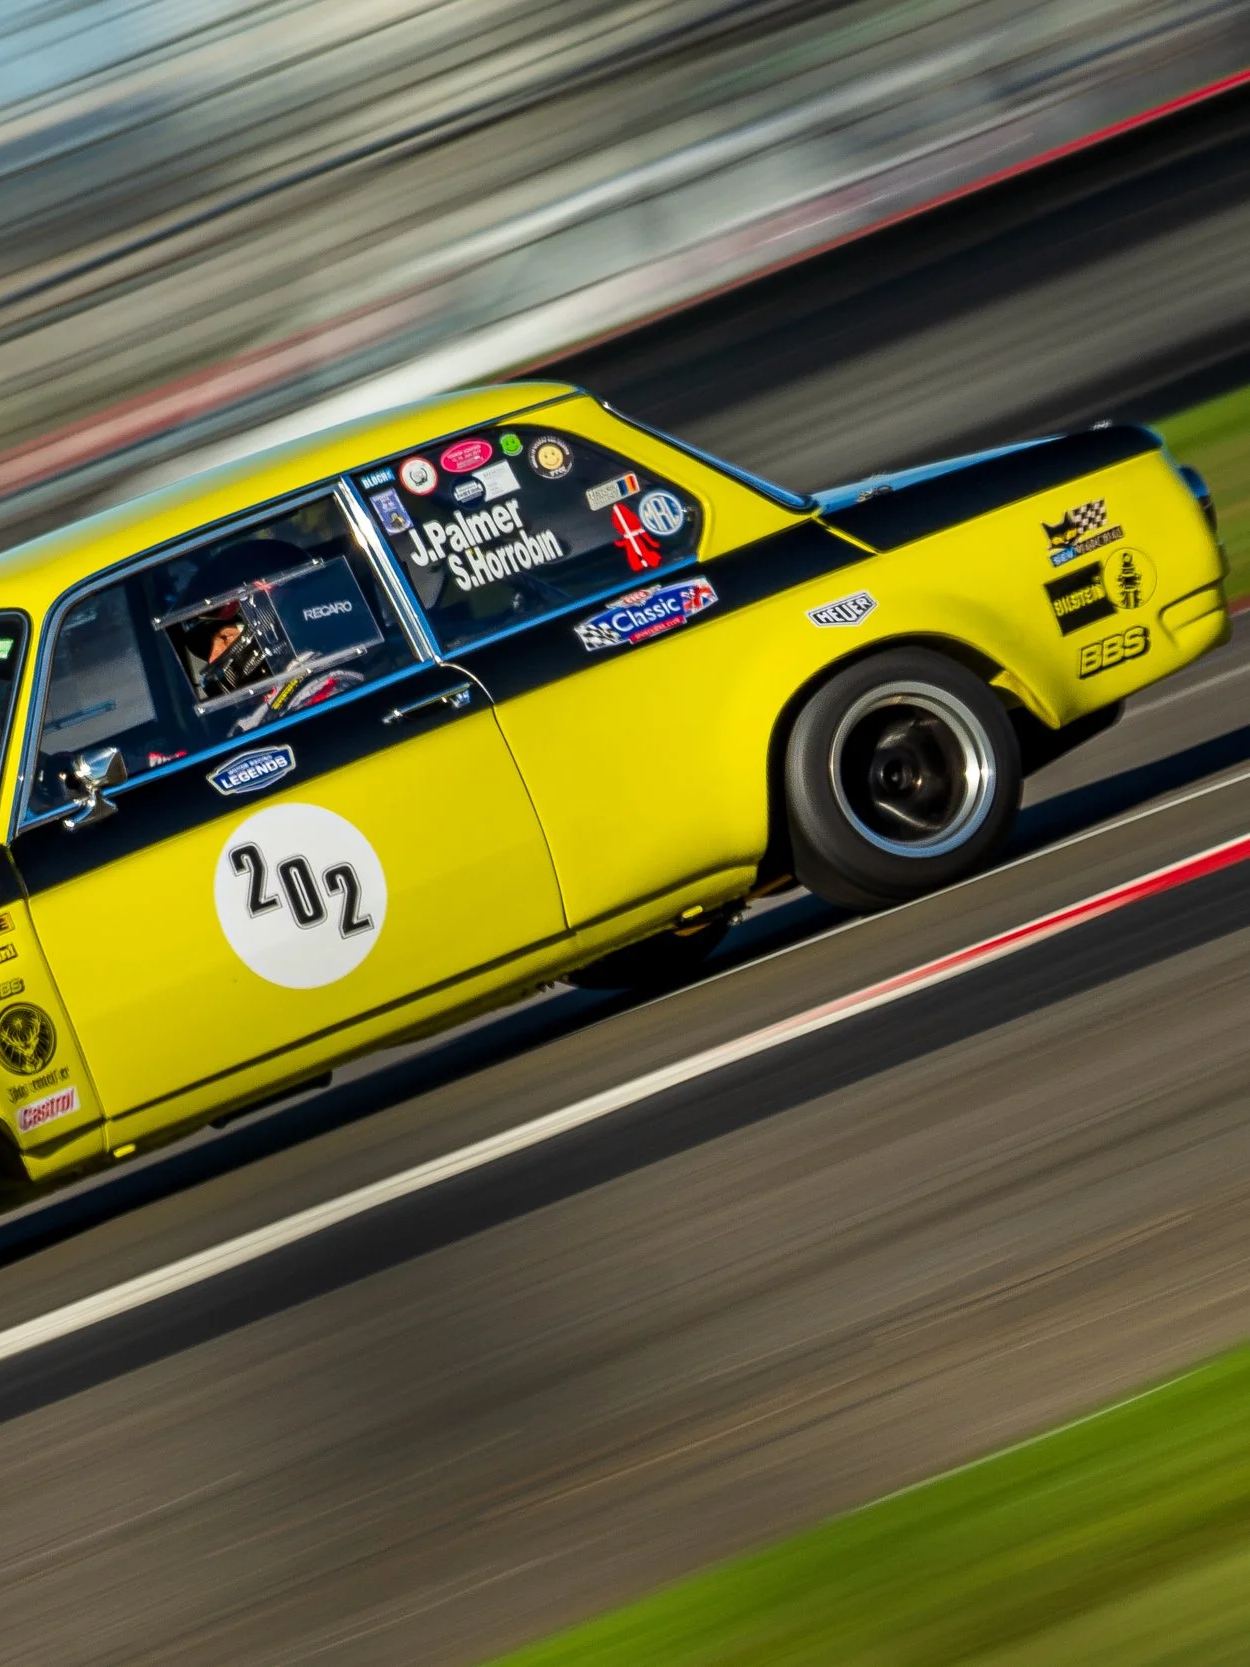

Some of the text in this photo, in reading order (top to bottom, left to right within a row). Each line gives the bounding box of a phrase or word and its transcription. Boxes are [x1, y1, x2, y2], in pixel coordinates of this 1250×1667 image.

[408, 498, 523, 566] J.Palmer
[644, 495, 680, 532] MRL
[447, 528, 564, 591] S.Horrobin
[302, 600, 353, 621] RECARO
[611, 597, 681, 633] Classic
[816, 598, 871, 623] HEUER
[1079, 625, 1150, 680] BBS
[220, 755, 288, 789] LEGENDS
[228, 841, 375, 940] 202
[21, 1087, 74, 1131] Castrol
